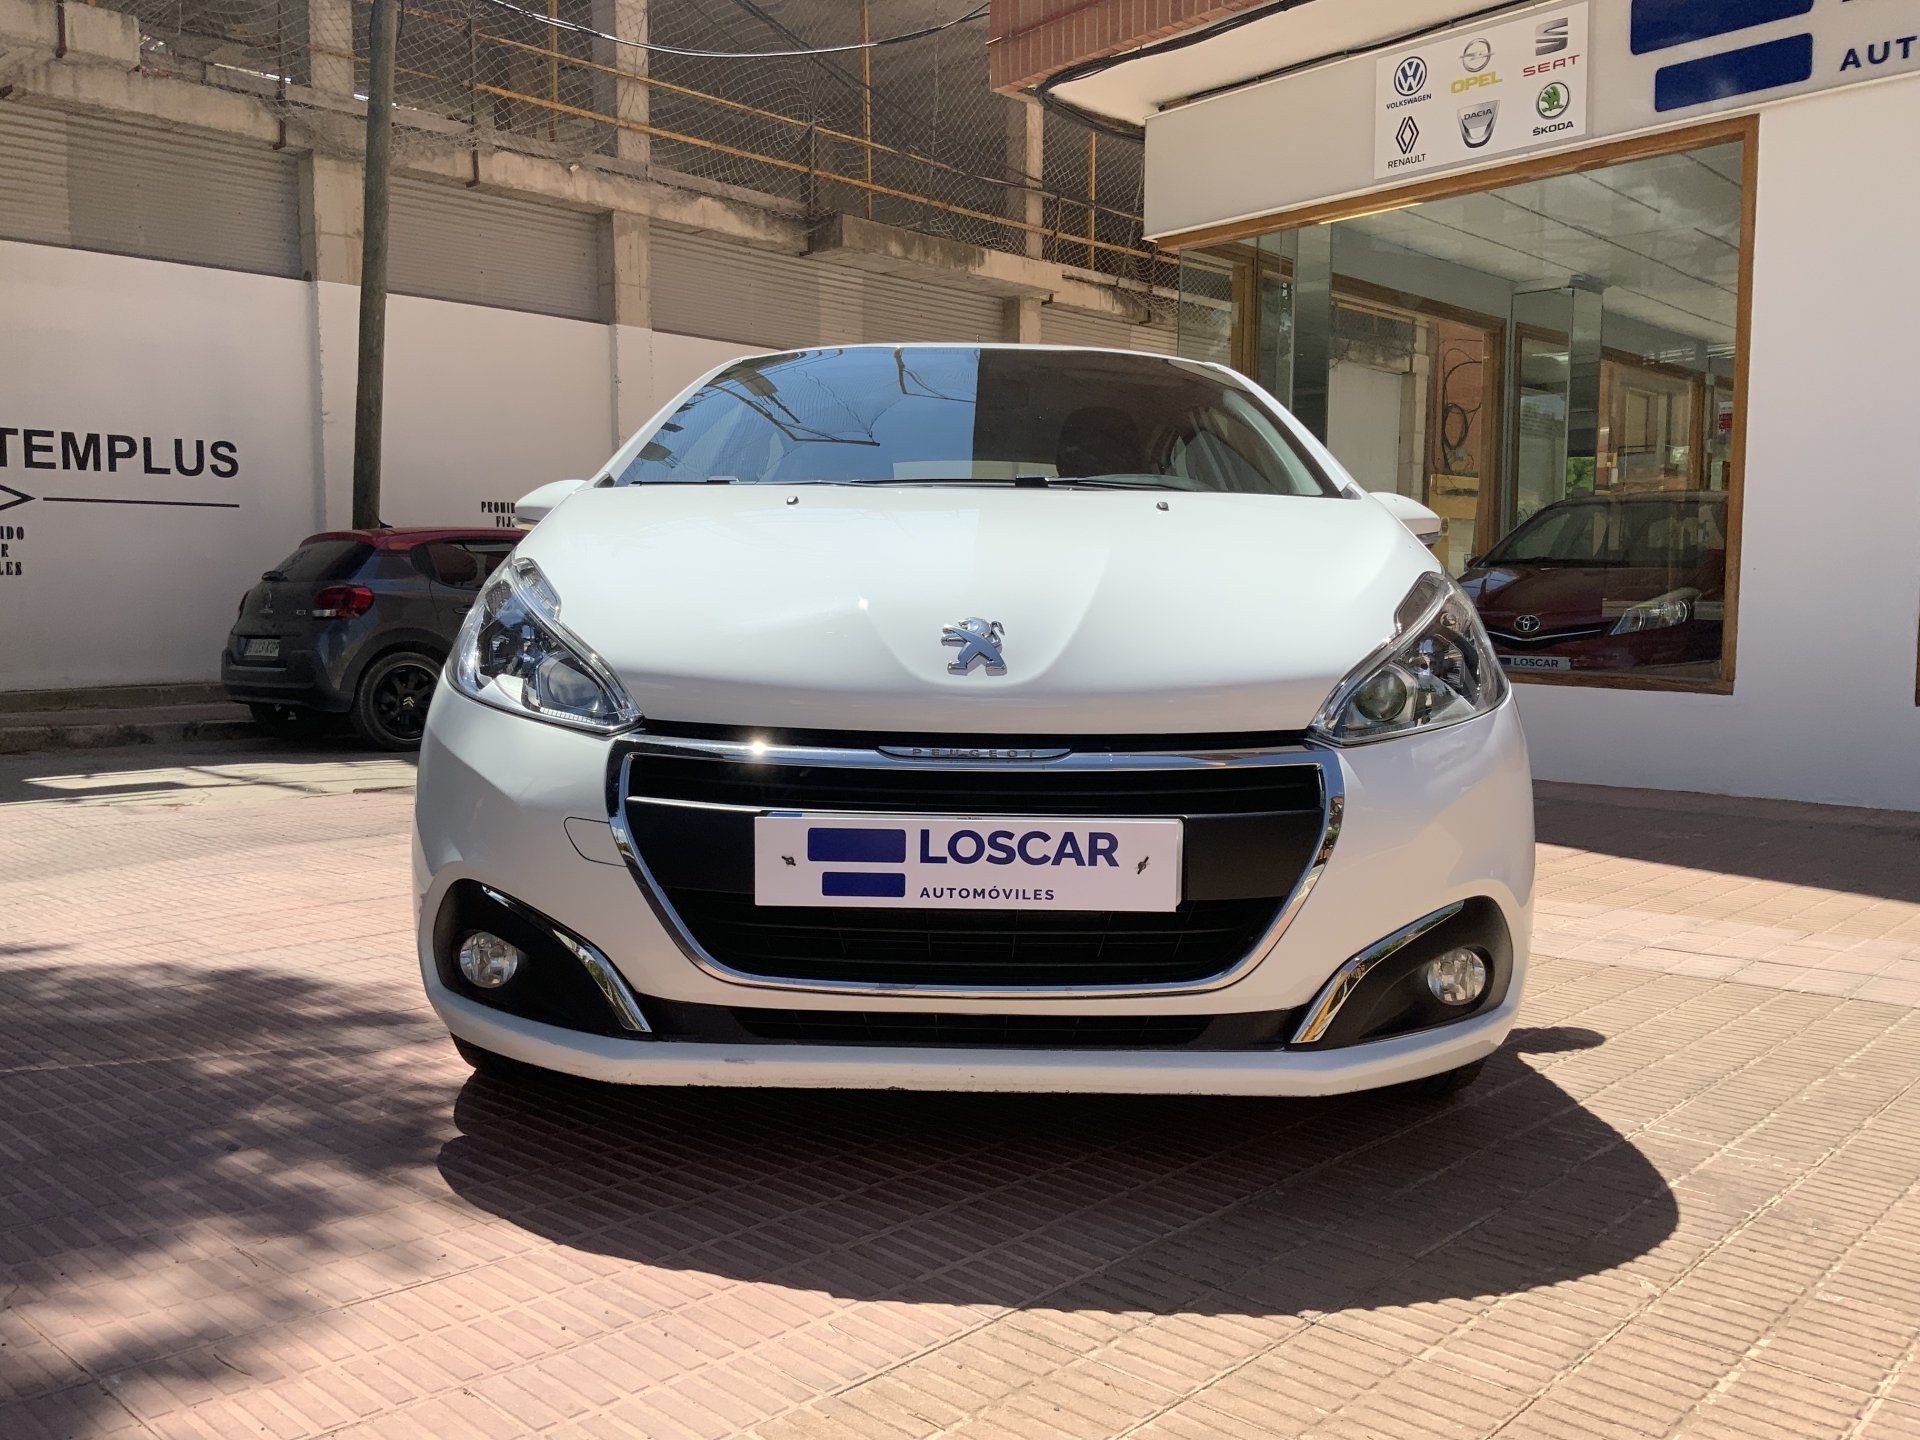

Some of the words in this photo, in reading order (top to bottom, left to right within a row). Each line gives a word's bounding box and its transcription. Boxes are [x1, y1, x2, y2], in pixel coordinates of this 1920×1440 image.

[1840, 35, 1918, 72] AUT
[1523, 54, 1580, 77] SEAT
[1451, 71, 1503, 94] OPEL
[1386, 93, 1432, 110] VOLKSWAGEN
[1463, 108, 1493, 121] DACIA
[1532, 120, 1574, 136] ŠKODA
[1387, 153, 1427, 169] RENAULT
[496, 516, 515, 527] FIJ
[1513, 657, 1559, 668] LOSCAR
[912, 748, 1036, 759] PEUGEOT
[920, 829, 1119, 867] LOSCAR
[920, 886, 1054, 900] AUTOMÓVILES
